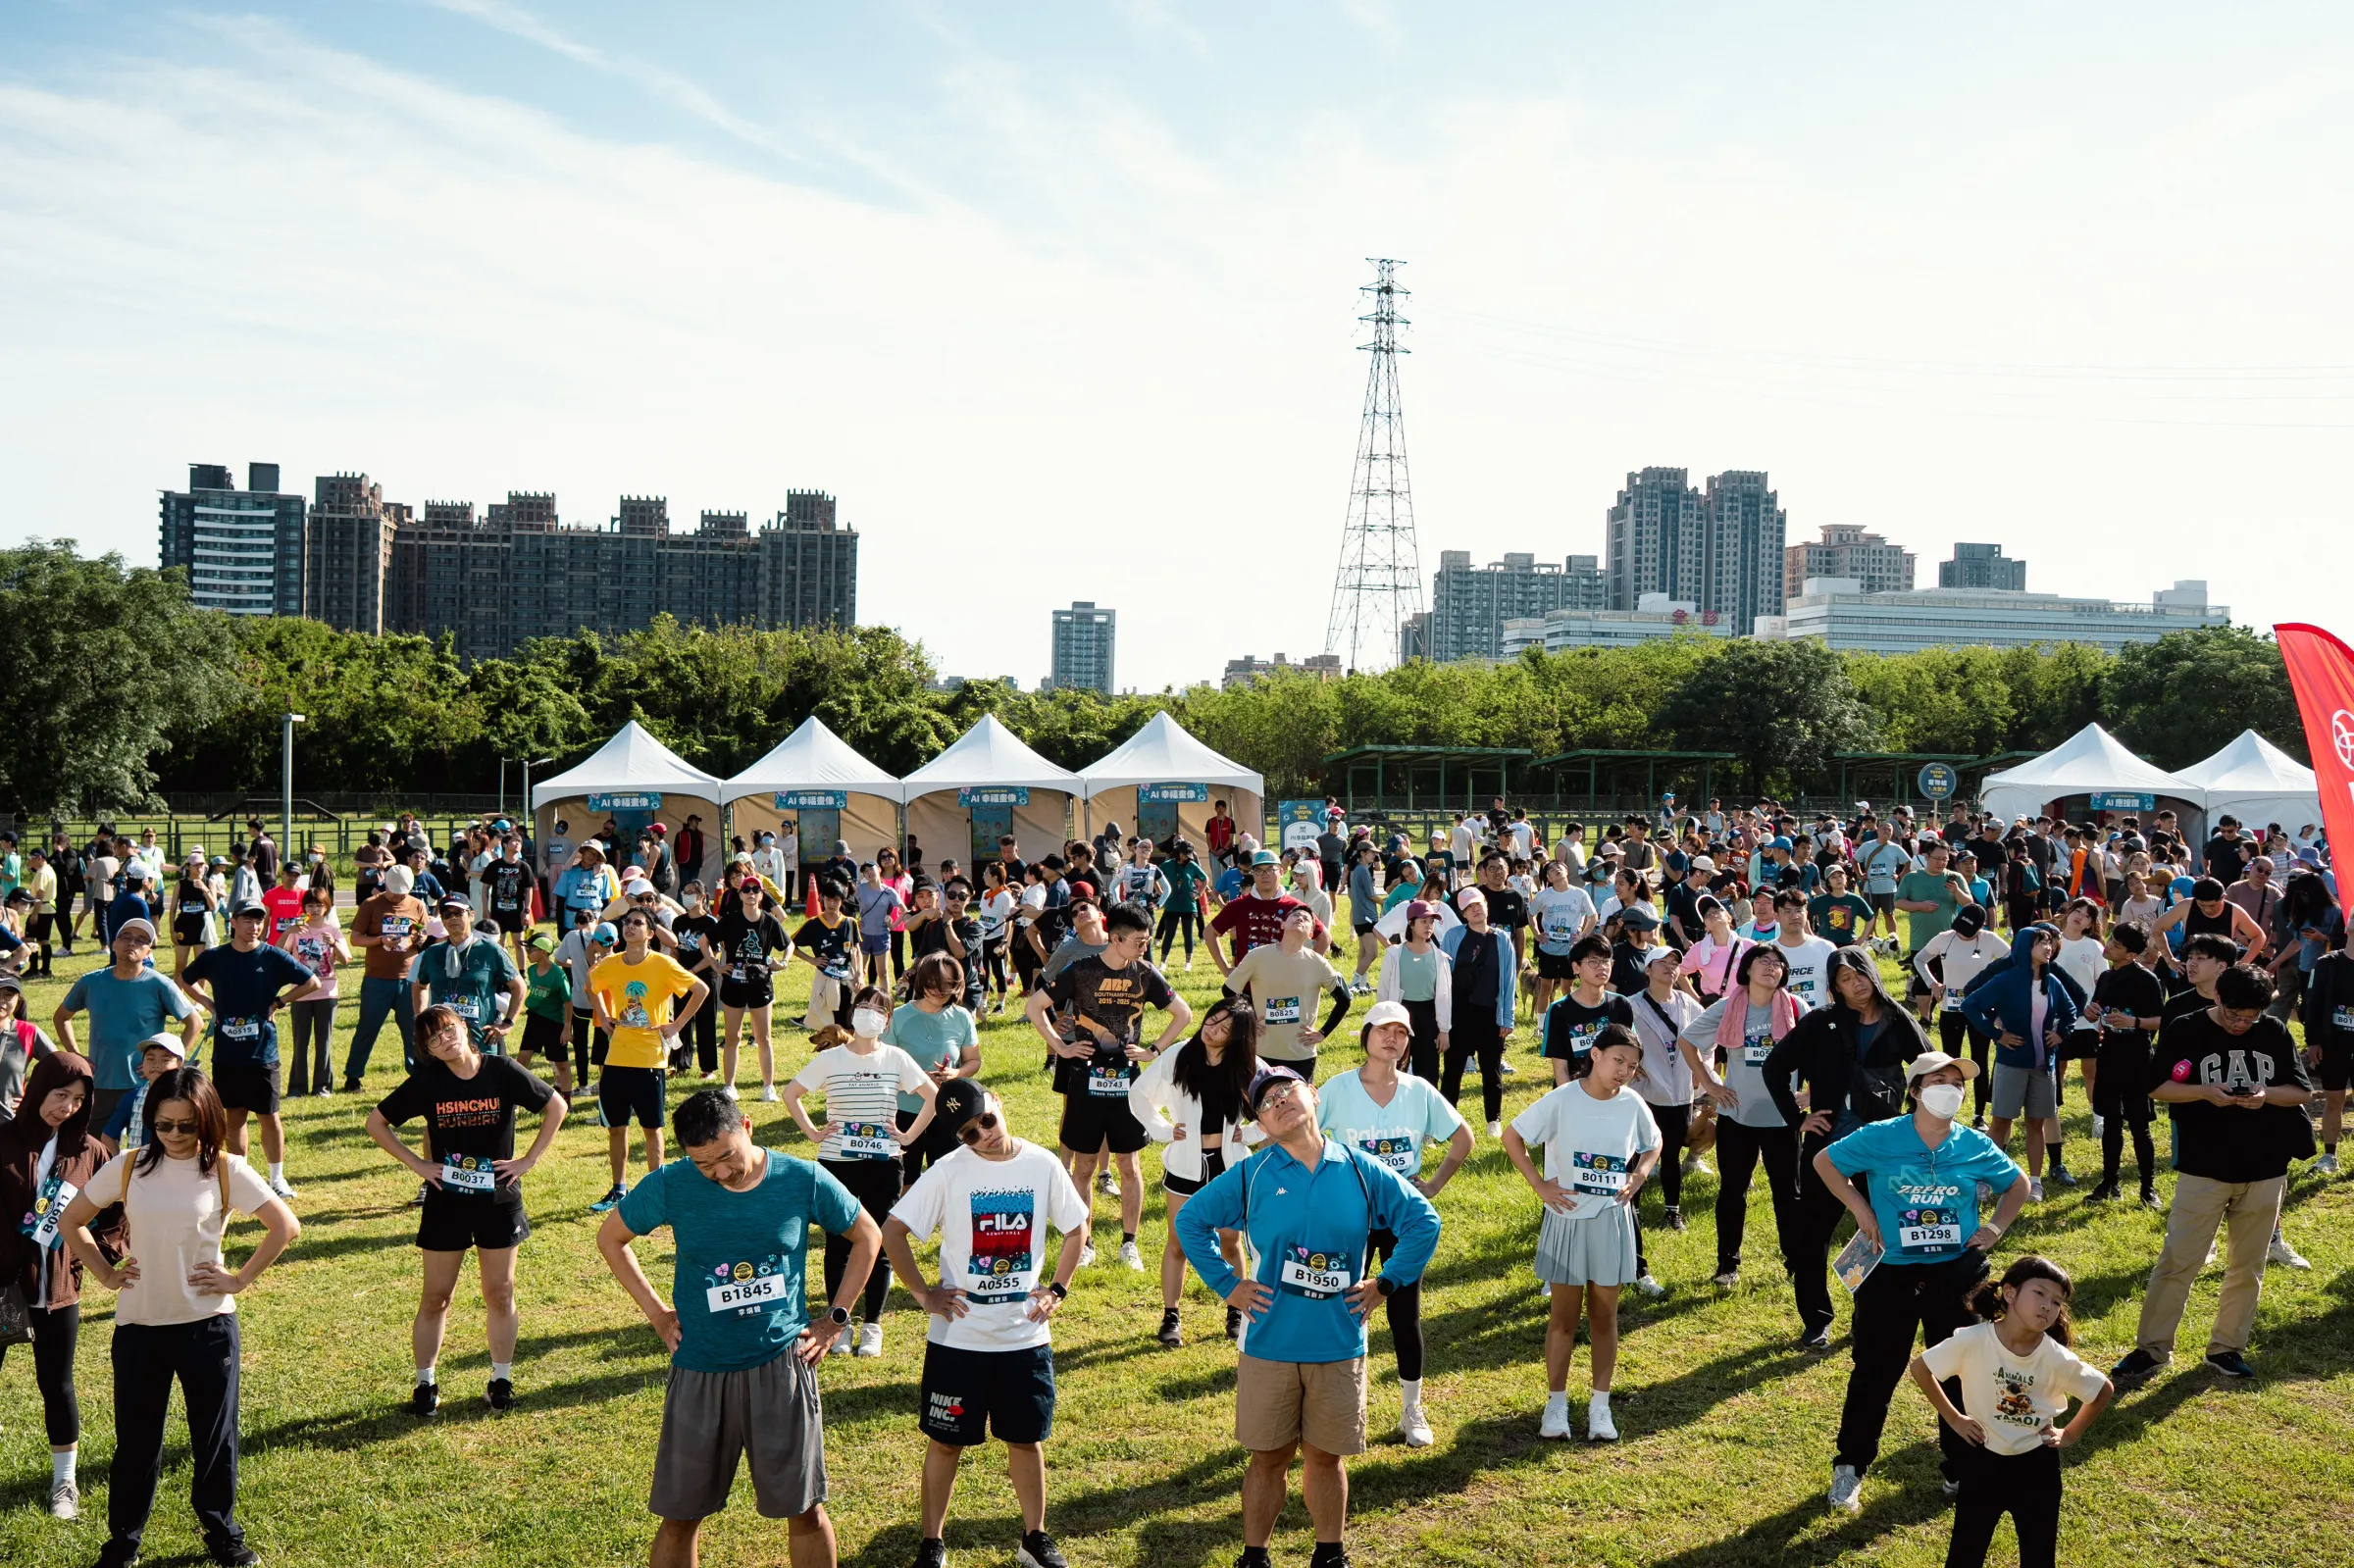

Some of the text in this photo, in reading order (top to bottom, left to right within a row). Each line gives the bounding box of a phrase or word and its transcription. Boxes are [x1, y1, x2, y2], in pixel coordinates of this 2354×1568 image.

[798, 795, 835, 805] 幸福畫像
[982, 793, 1016, 803] 幸福畫像
[1161, 789, 1196, 799] 幸福畫像
[612, 797, 648, 808] 幸福畫像
[1270, 1009, 1294, 1018] B0825
[2338, 1016, 2353, 1025] B01
[228, 1027, 252, 1036] A0519
[1746, 1023, 1772, 1036] REAMY
[2200, 1049, 2275, 1087] GAP
[436, 1097, 498, 1115] HSINCHU
[437, 1114, 502, 1130] RUNBIRD
[850, 1138, 883, 1150] B0746
[452, 1171, 486, 1185] B0037
[1582, 1172, 1617, 1185] B0111
[1898, 1185, 1960, 1196] ZEPRO
[1909, 1194, 1945, 1205] RUN
[43, 1192, 72, 1236] B0911
[979, 1213, 1028, 1232] FILA
[1911, 1229, 1952, 1241] B1298
[978, 1277, 1020, 1290] A0555
[1295, 1268, 1340, 1288] B1950
[722, 1283, 773, 1303] B1845
[1998, 1366, 2035, 1387] ANIMALS
[929, 1391, 963, 1407] NIKE
[928, 1405, 955, 1422] INC.
